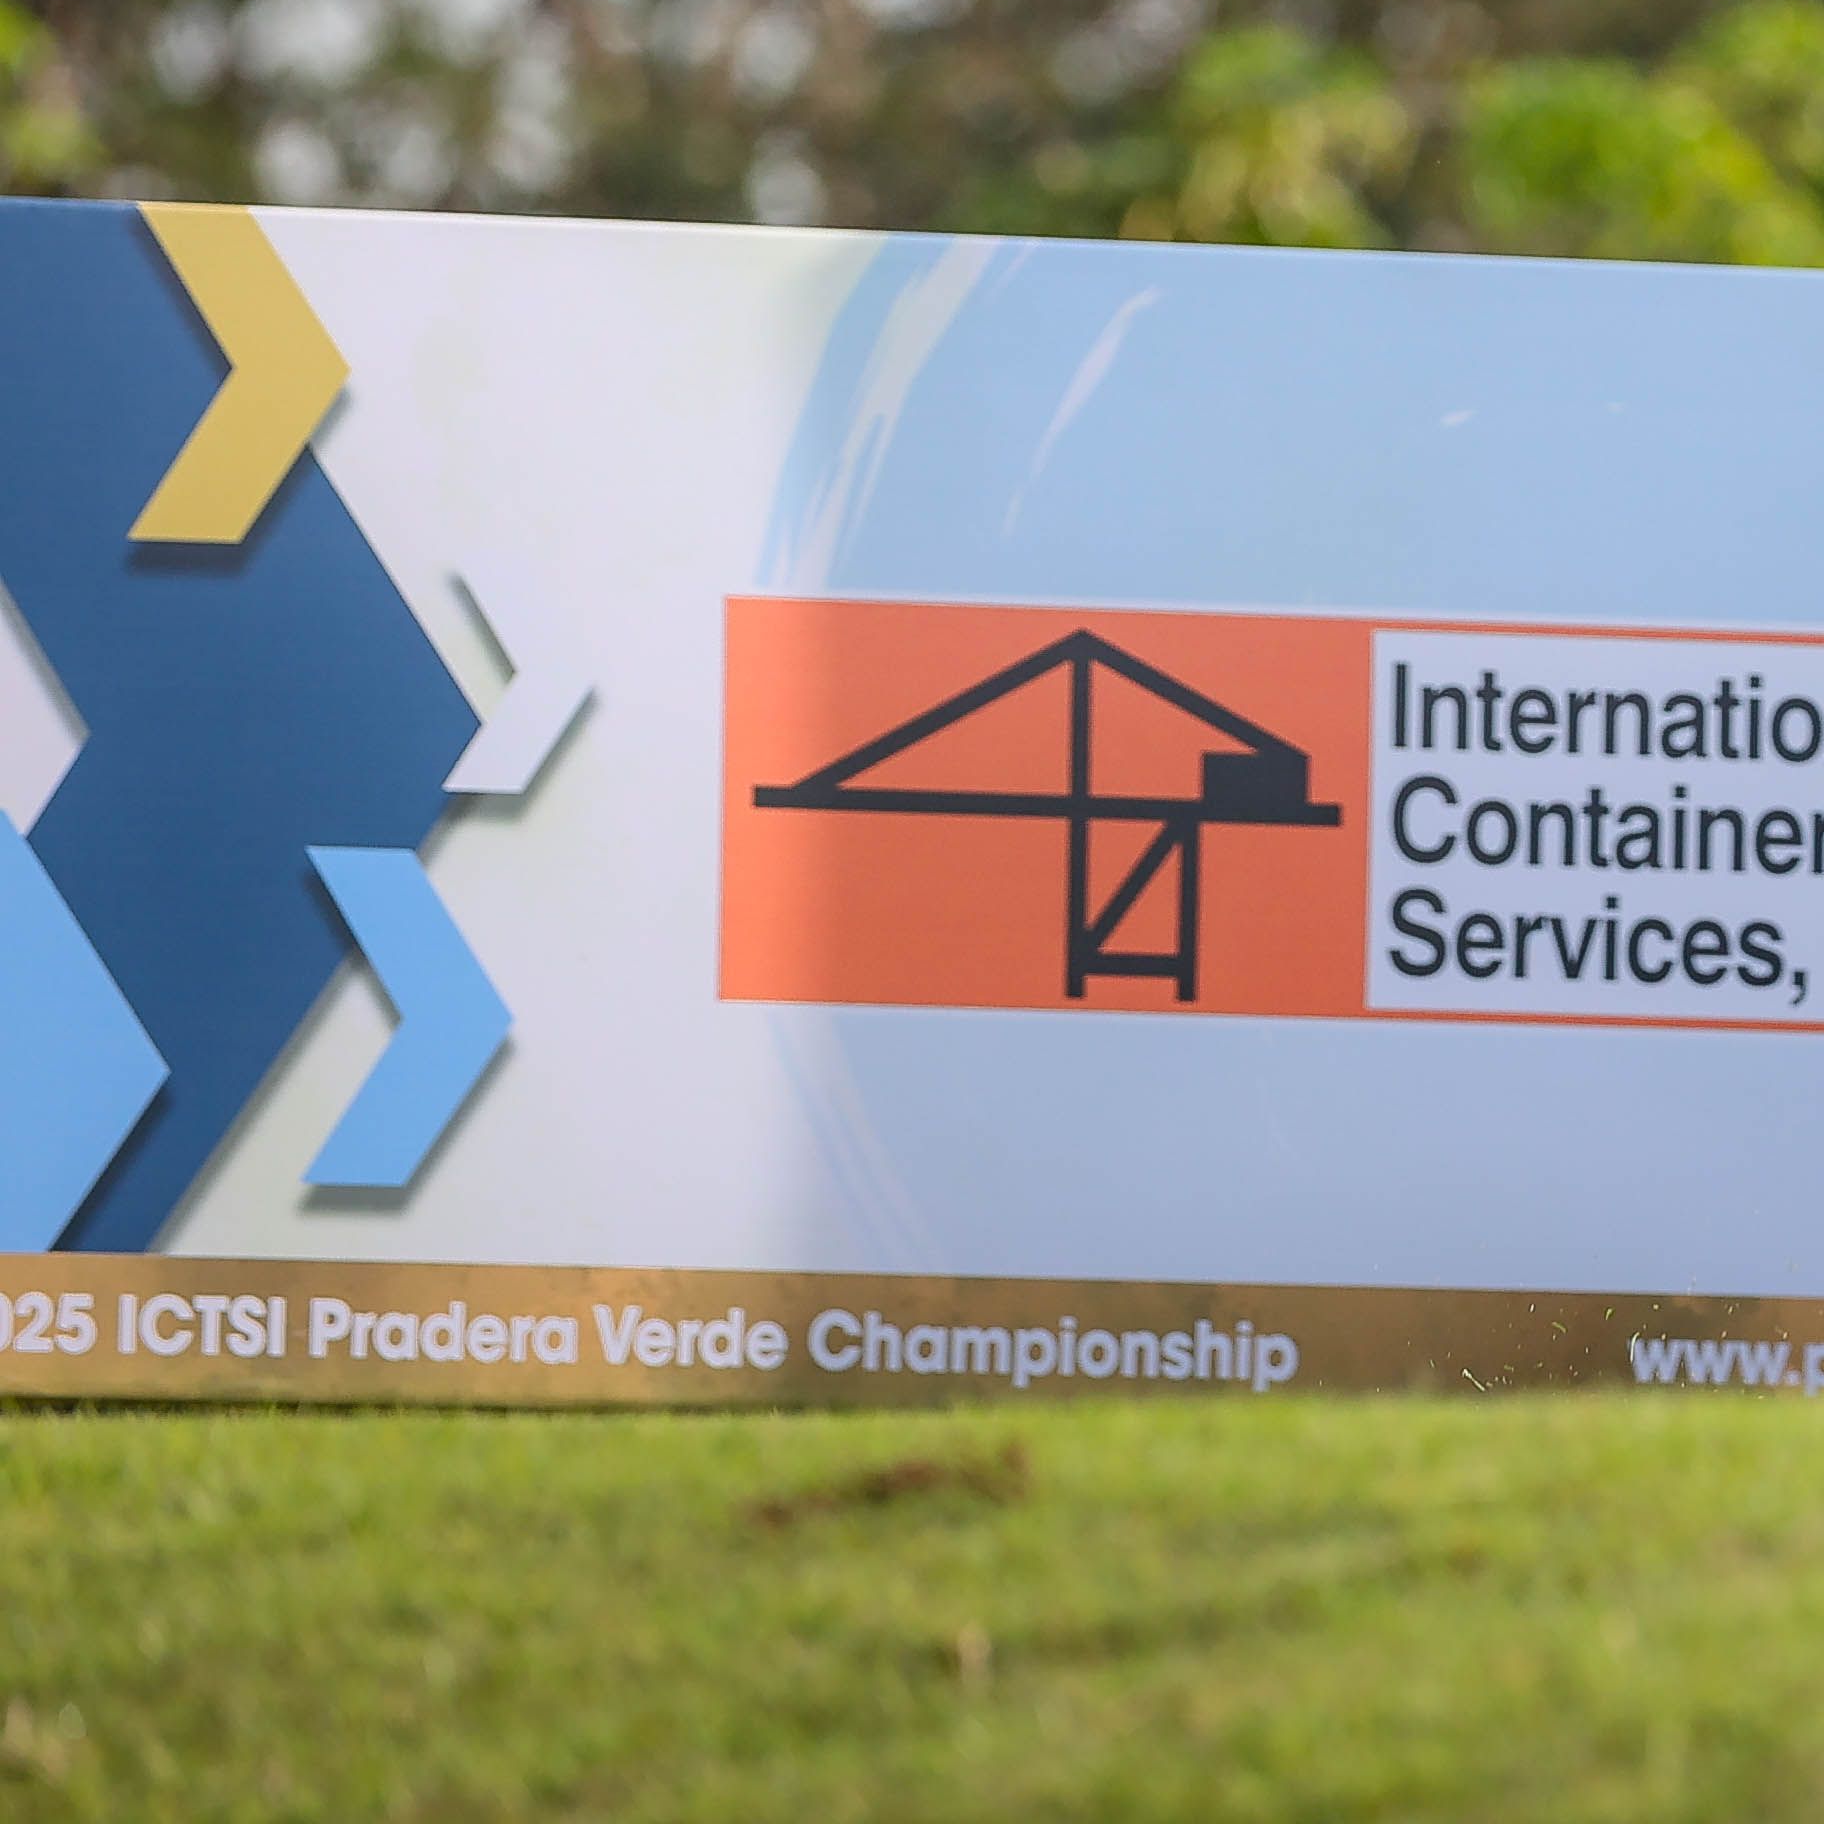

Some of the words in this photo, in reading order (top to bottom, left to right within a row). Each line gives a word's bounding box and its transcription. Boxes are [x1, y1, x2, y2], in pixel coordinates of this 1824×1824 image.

[1388, 887, 1807, 1005] Services,
[0, 1291, 97, 1356] 25
[117, 1293, 287, 1357] ICTSI
[308, 1297, 579, 1365] Pradera
[593, 1304, 789, 1369] Verde
[808, 1308, 1299, 1392] Championship
